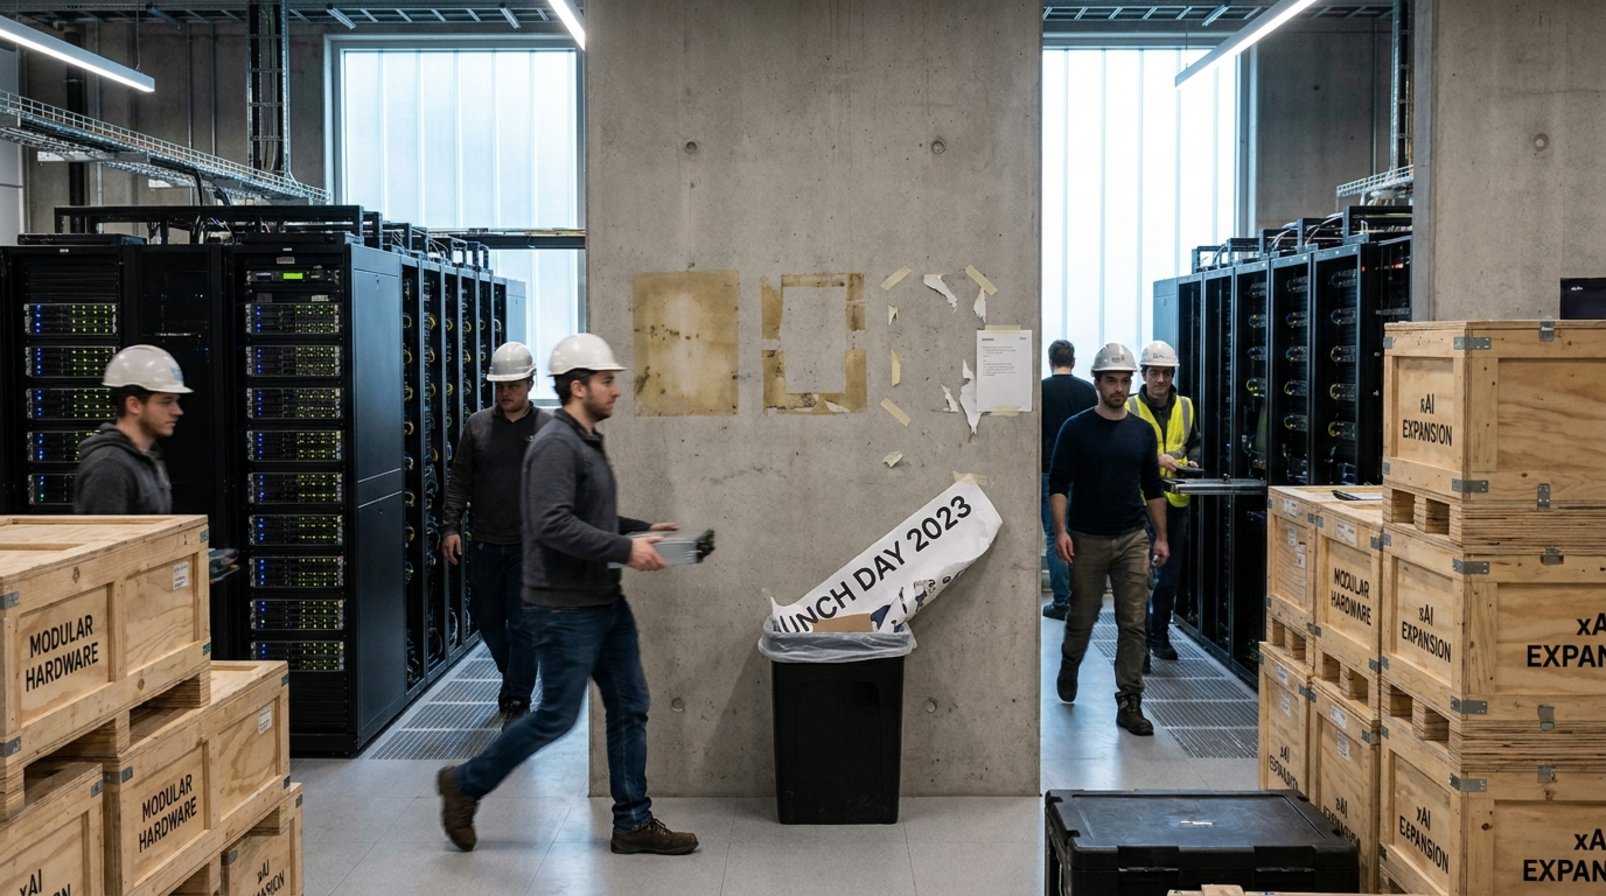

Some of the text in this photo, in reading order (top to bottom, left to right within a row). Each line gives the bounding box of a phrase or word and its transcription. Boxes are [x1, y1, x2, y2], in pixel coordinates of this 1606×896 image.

[1402, 419, 1453, 447] EXPANSION
[852, 540, 906, 592] DAY
[906, 495, 972, 552] 2023
[29, 614, 94, 659] MODULAR
[1401, 620, 1452, 664] EXPANSION
[25, 641, 99, 693] HARDWARE
[142, 773, 193, 823] MODULAR
[138, 795, 198, 854] HARDWARE
